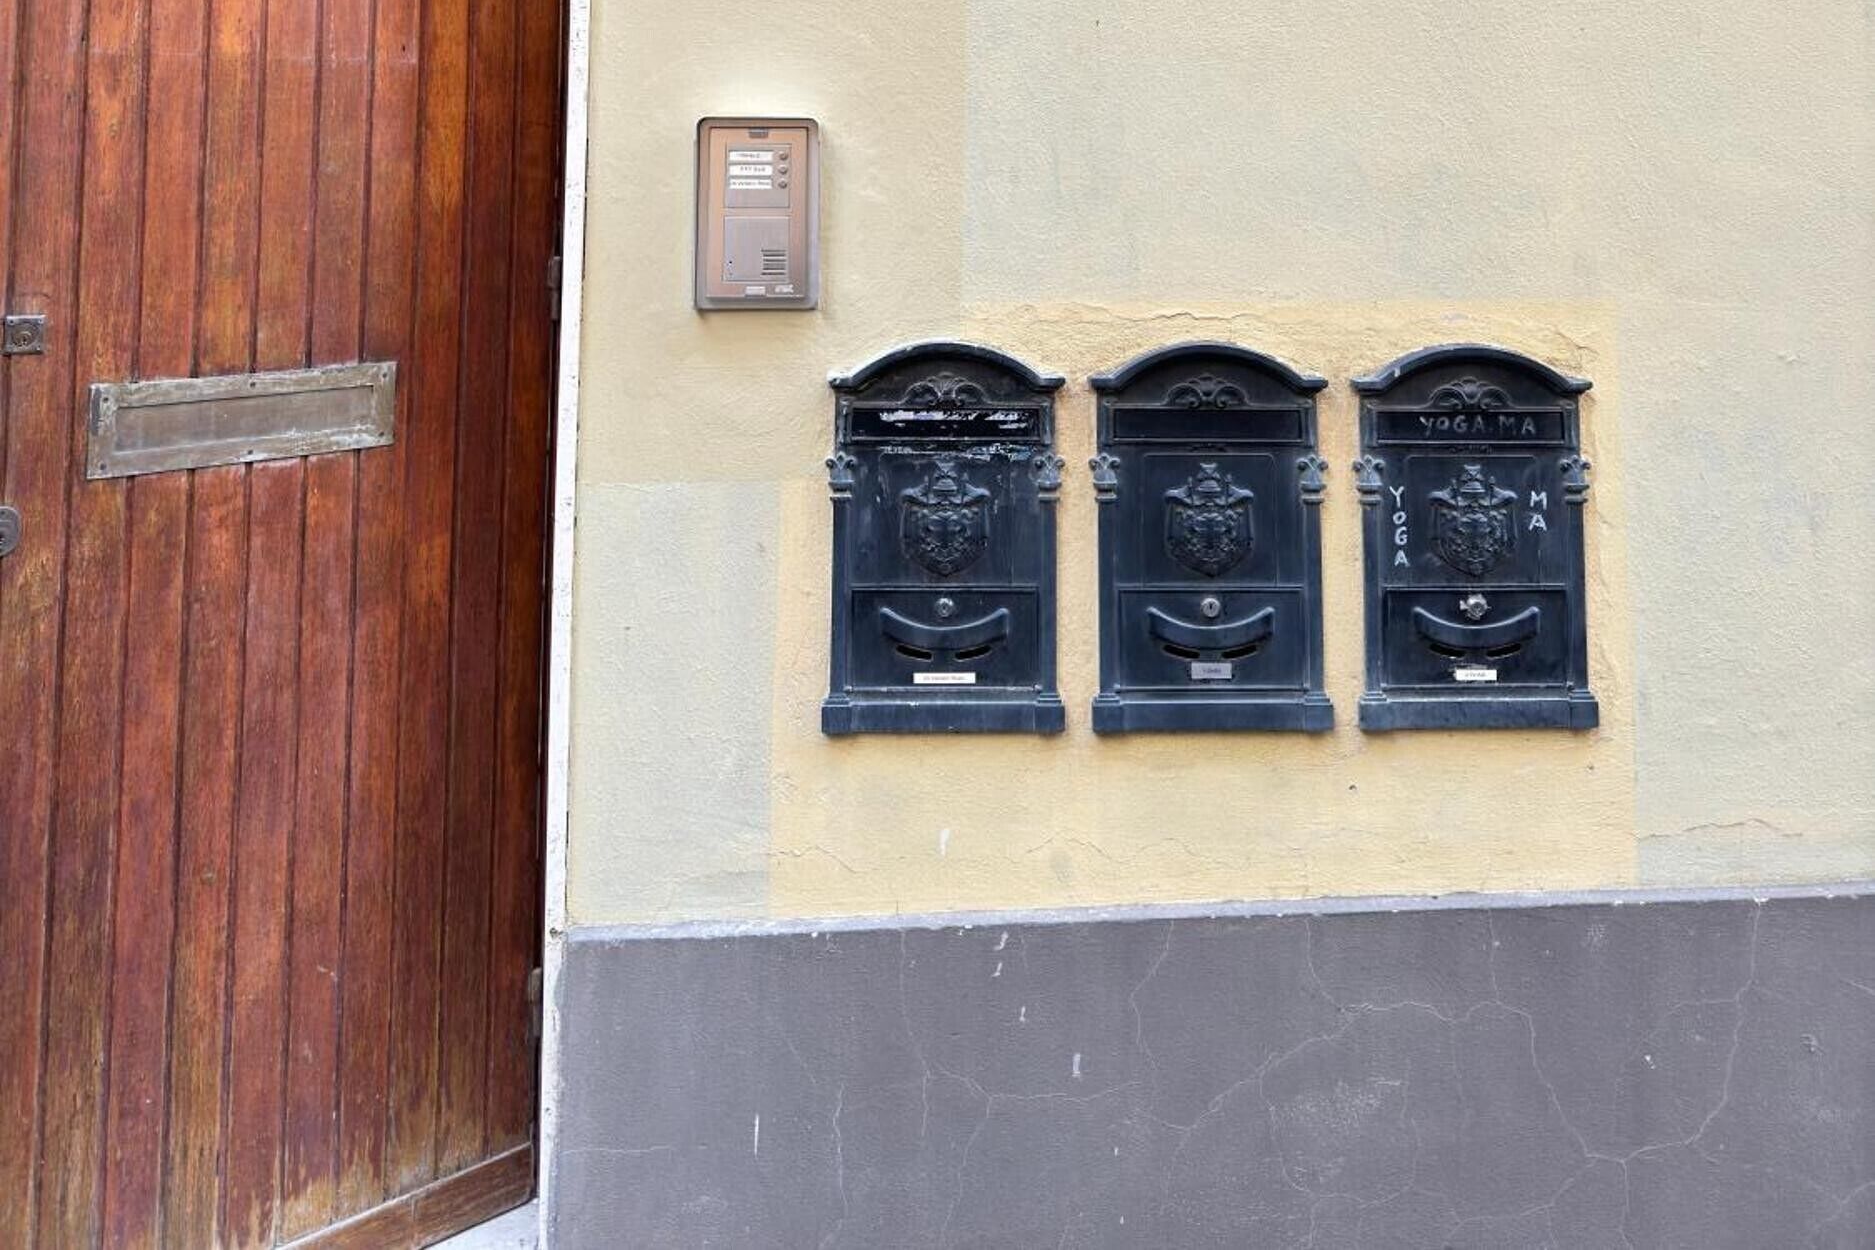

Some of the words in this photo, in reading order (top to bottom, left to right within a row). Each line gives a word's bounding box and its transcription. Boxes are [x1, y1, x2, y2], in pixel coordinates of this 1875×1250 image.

[1499, 415, 1536, 435] MA
[1389, 485, 1411, 567] YOGA
[1528, 490, 1548, 532] MA
